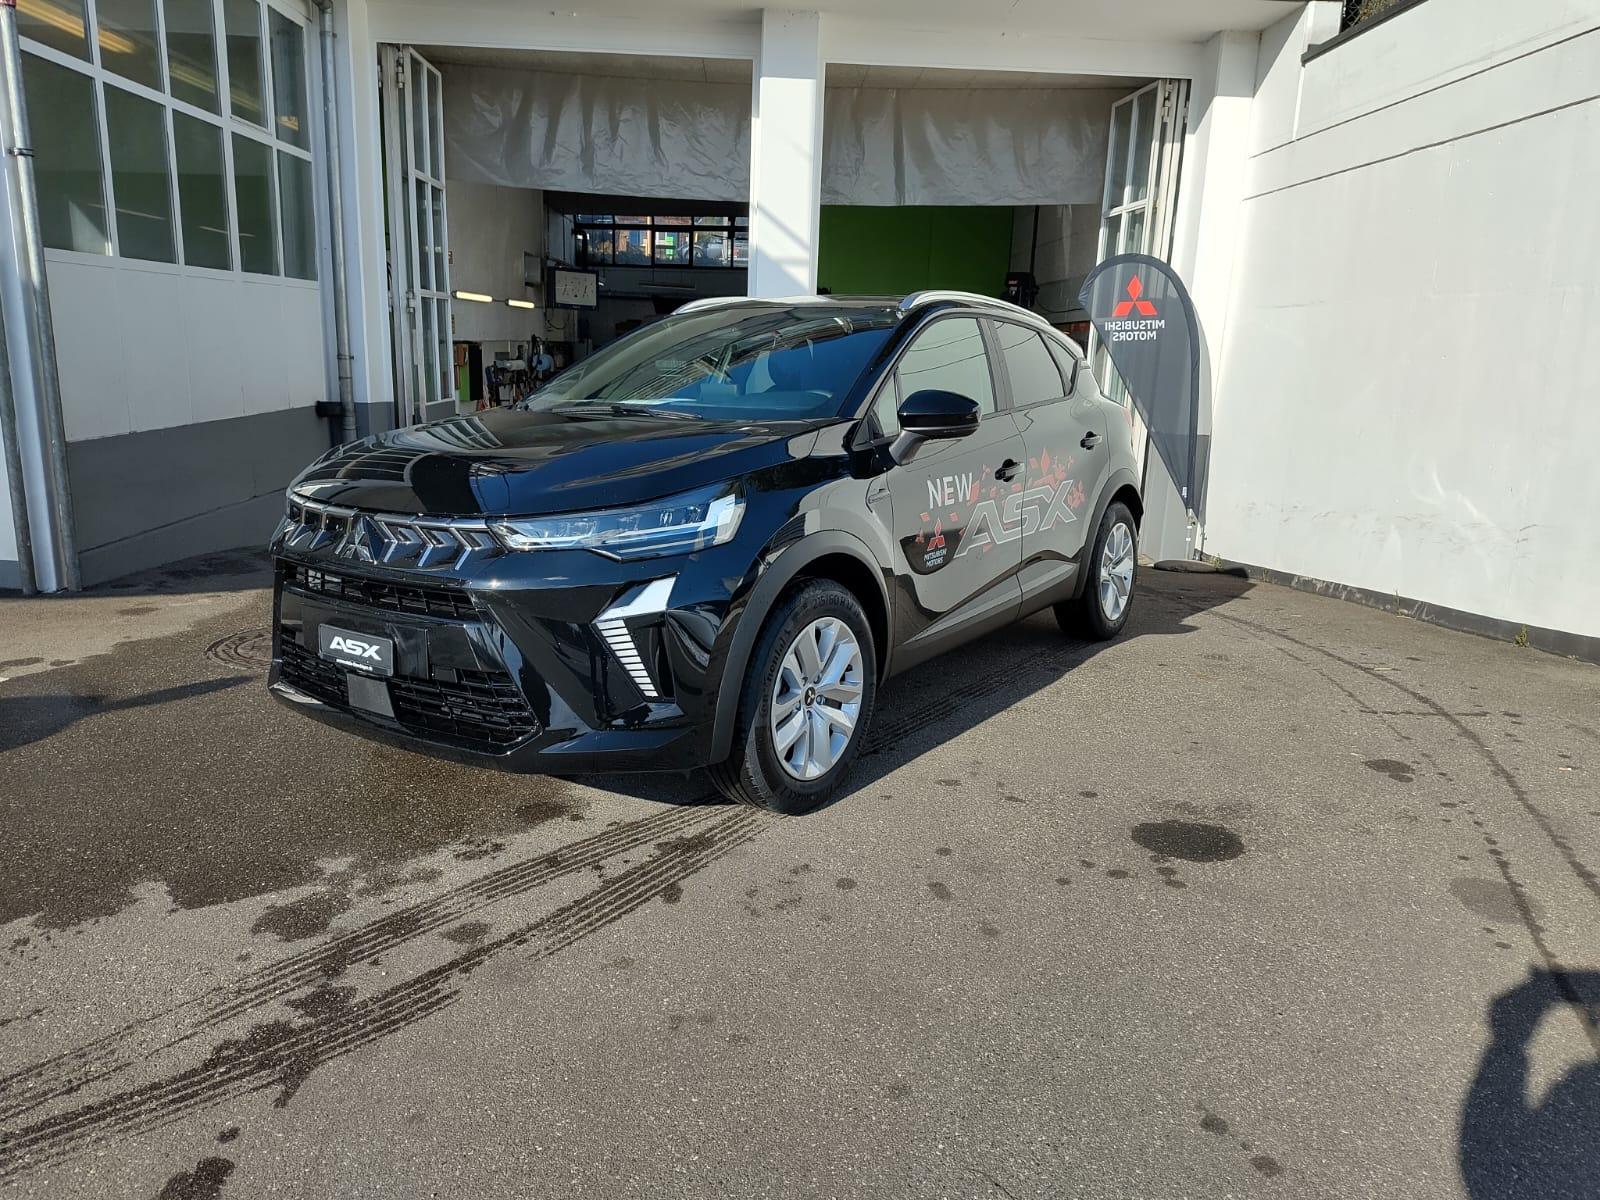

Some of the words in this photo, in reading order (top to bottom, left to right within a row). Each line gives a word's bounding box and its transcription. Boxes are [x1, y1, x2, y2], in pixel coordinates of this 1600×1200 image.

[926, 472, 973, 509] NEW
[953, 479, 1078, 559] ASX
[329, 635, 382, 661] ASX
